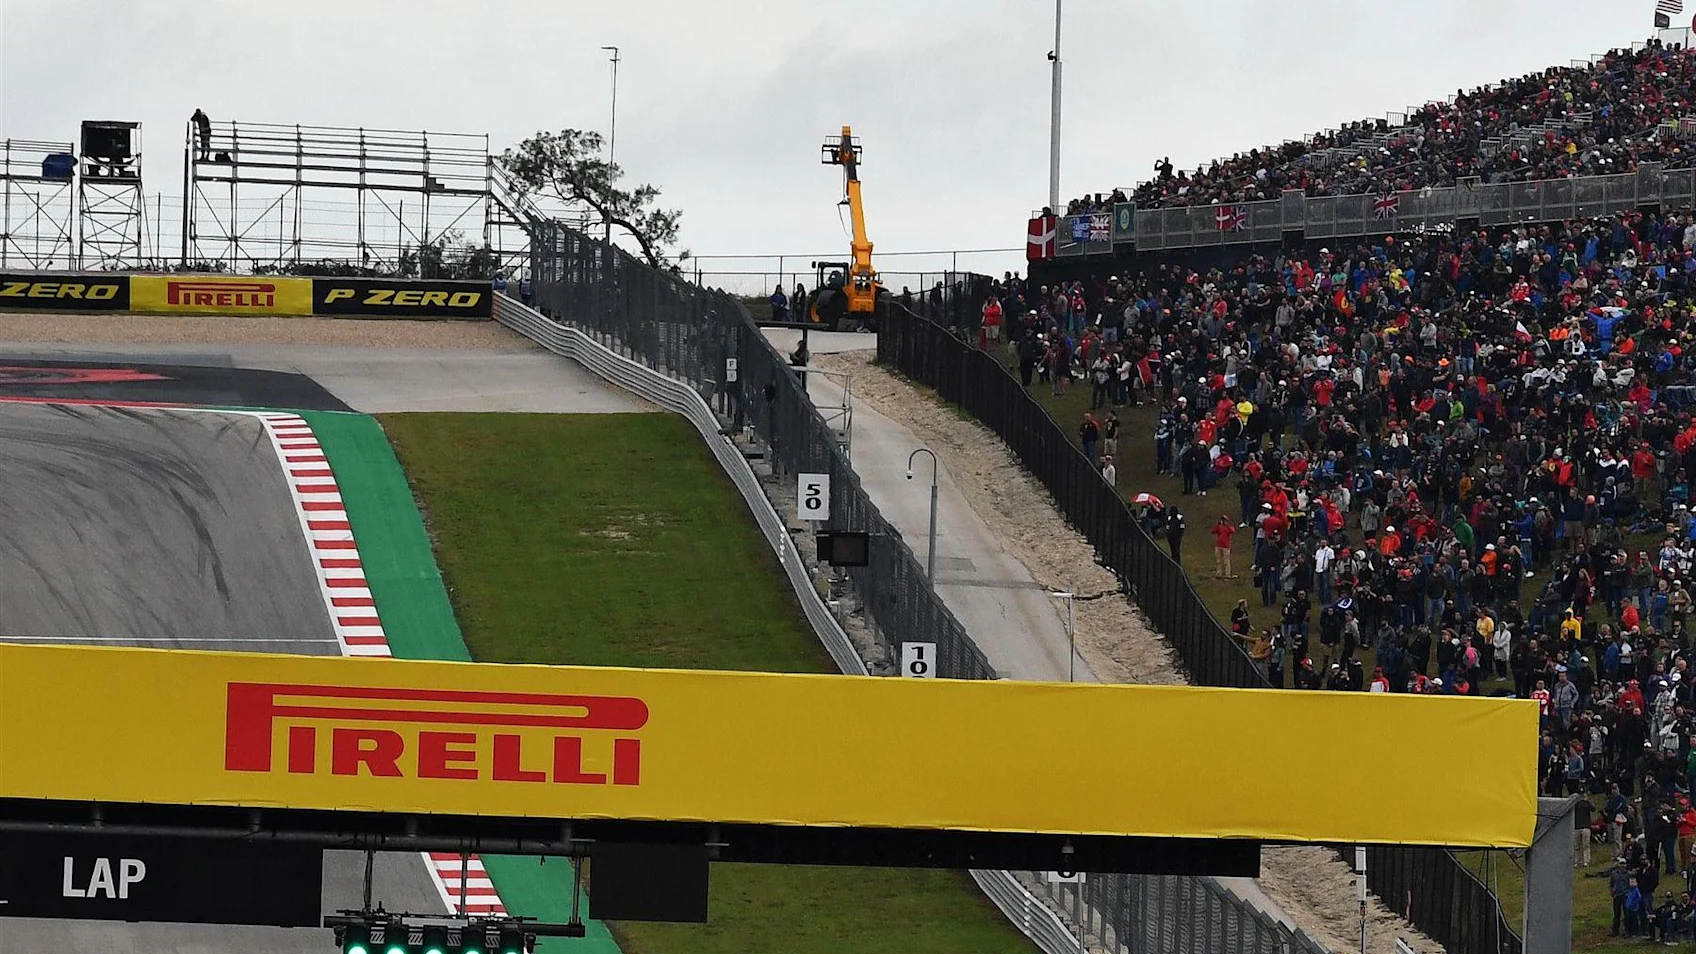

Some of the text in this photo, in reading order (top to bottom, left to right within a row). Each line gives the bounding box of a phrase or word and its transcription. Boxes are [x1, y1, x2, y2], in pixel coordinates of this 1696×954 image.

[0, 282, 119, 300] ZERO
[168, 281, 276, 307] PIRELLI
[324, 288, 482, 308] P ZERO
[805, 484, 822, 510] 50
[910, 646, 928, 677] 10
[225, 682, 649, 785] PIRELLI
[62, 856, 148, 899] LAP
